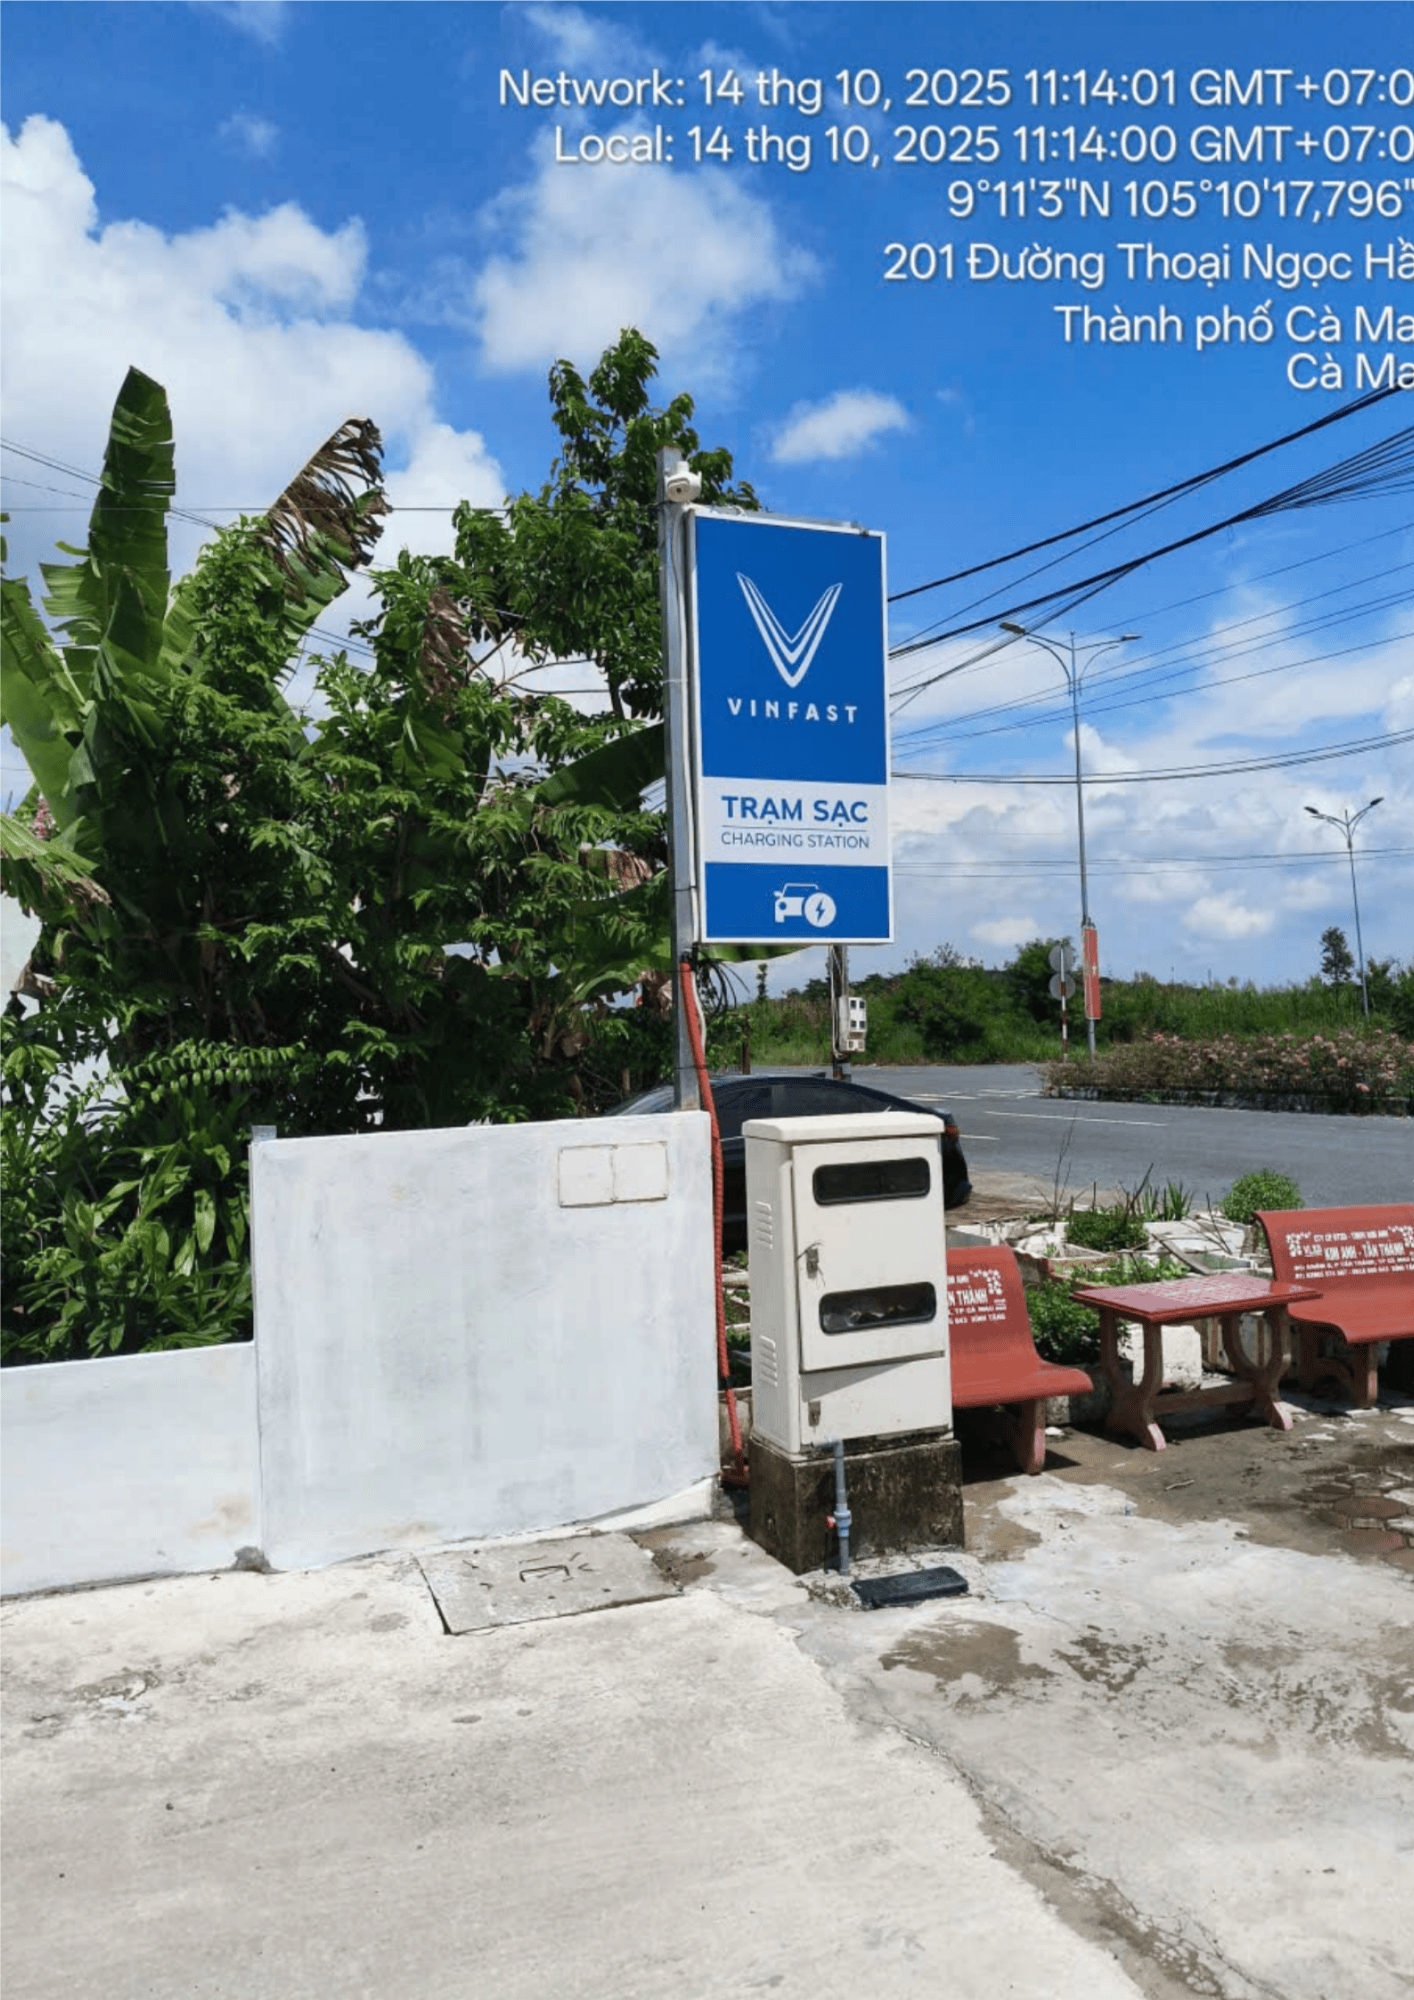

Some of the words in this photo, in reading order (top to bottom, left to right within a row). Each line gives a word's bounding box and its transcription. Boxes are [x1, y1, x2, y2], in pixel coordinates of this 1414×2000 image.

[727, 697, 858, 724] VINFAST
[721, 795, 803, 826] TRẠM
[813, 799, 869, 828] SẠC
[721, 830, 804, 848] CHARGING
[807, 832, 870, 850] STATION
